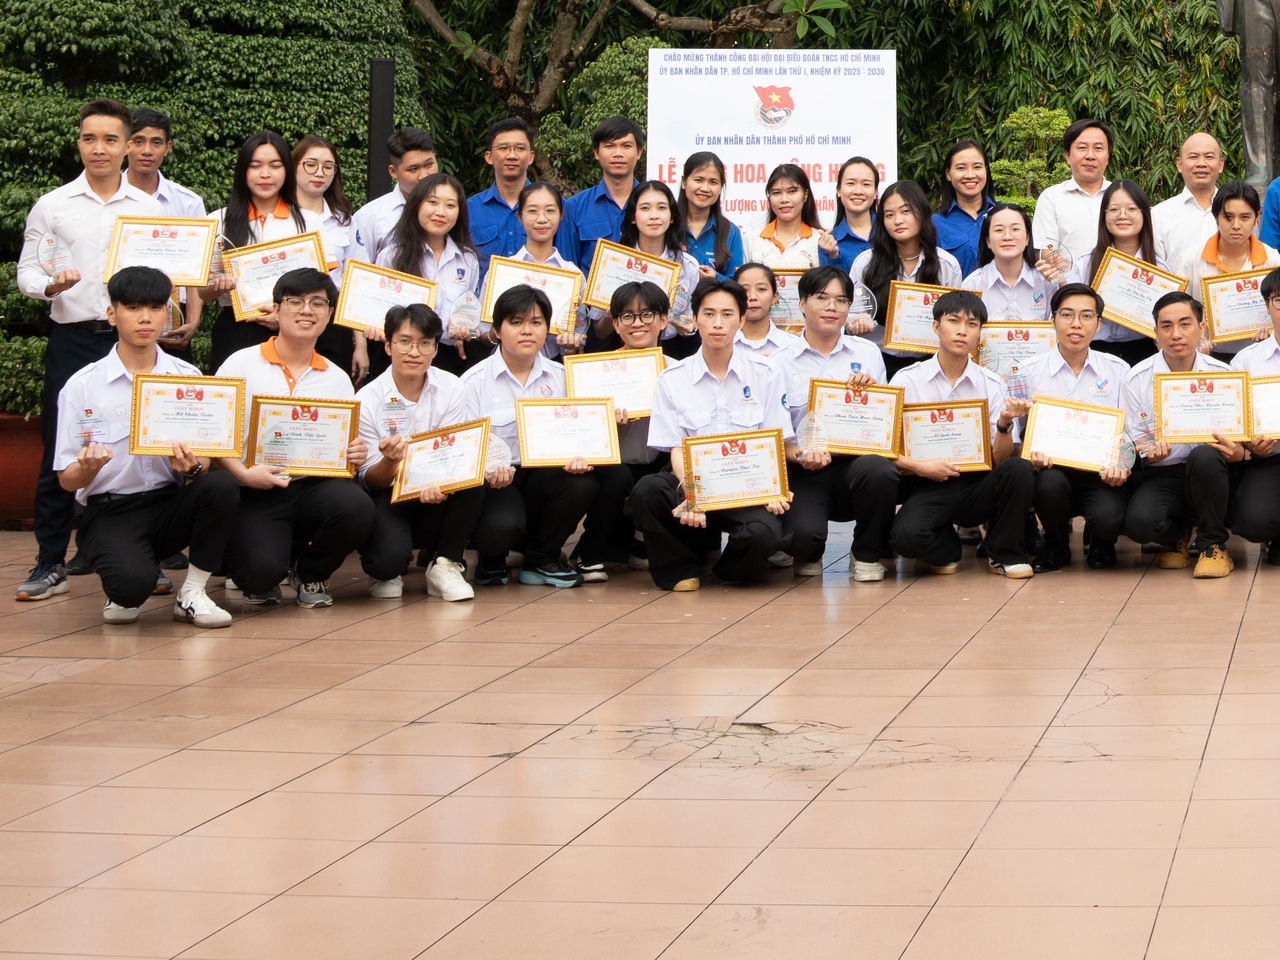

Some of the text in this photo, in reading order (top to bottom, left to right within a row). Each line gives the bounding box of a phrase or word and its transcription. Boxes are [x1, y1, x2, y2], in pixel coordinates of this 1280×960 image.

[663, 52, 681, 62] CHÀO
[706, 52, 727, 62] THÀNH
[729, 51, 746, 62] CÔNG
[748, 53, 759, 63] ĐẠI
[761, 52, 772, 64] HỘI
[773, 54, 785, 64] ĐẠI
[802, 51, 820, 62] ĐOÀN
[822, 54, 838, 62] TNCS
[850, 51, 861, 62] CHÍ
[863, 54, 881, 62] MINH
[670, 67, 683, 76] BAN
[685, 65, 703, 76] NHÂN
[705, 65, 718, 76] DÂN
[720, 67, 730, 76] TP.
[742, 64, 754, 76] CHÍ
[755, 67, 773, 76] MINH
[810, 65, 831, 78] NHIỆM
[843, 67, 861, 76] 2025
[867, 67, 885, 76] 2030
[695, 133, 705, 146] ỦY
[707, 136, 722, 146] BAN
[724, 134, 744, 146] NHÂN
[746, 134, 761, 146] DÂN
[763, 134, 787, 146] THÀNH
[789, 133, 804, 145] PHỐ
[817, 133, 830, 145] CHÍ
[831, 136, 851, 145] MINH
[658, 157, 677, 183] LỄ
[725, 199, 757, 214] LƯỢNG
[815, 196, 835, 211] HÂN
